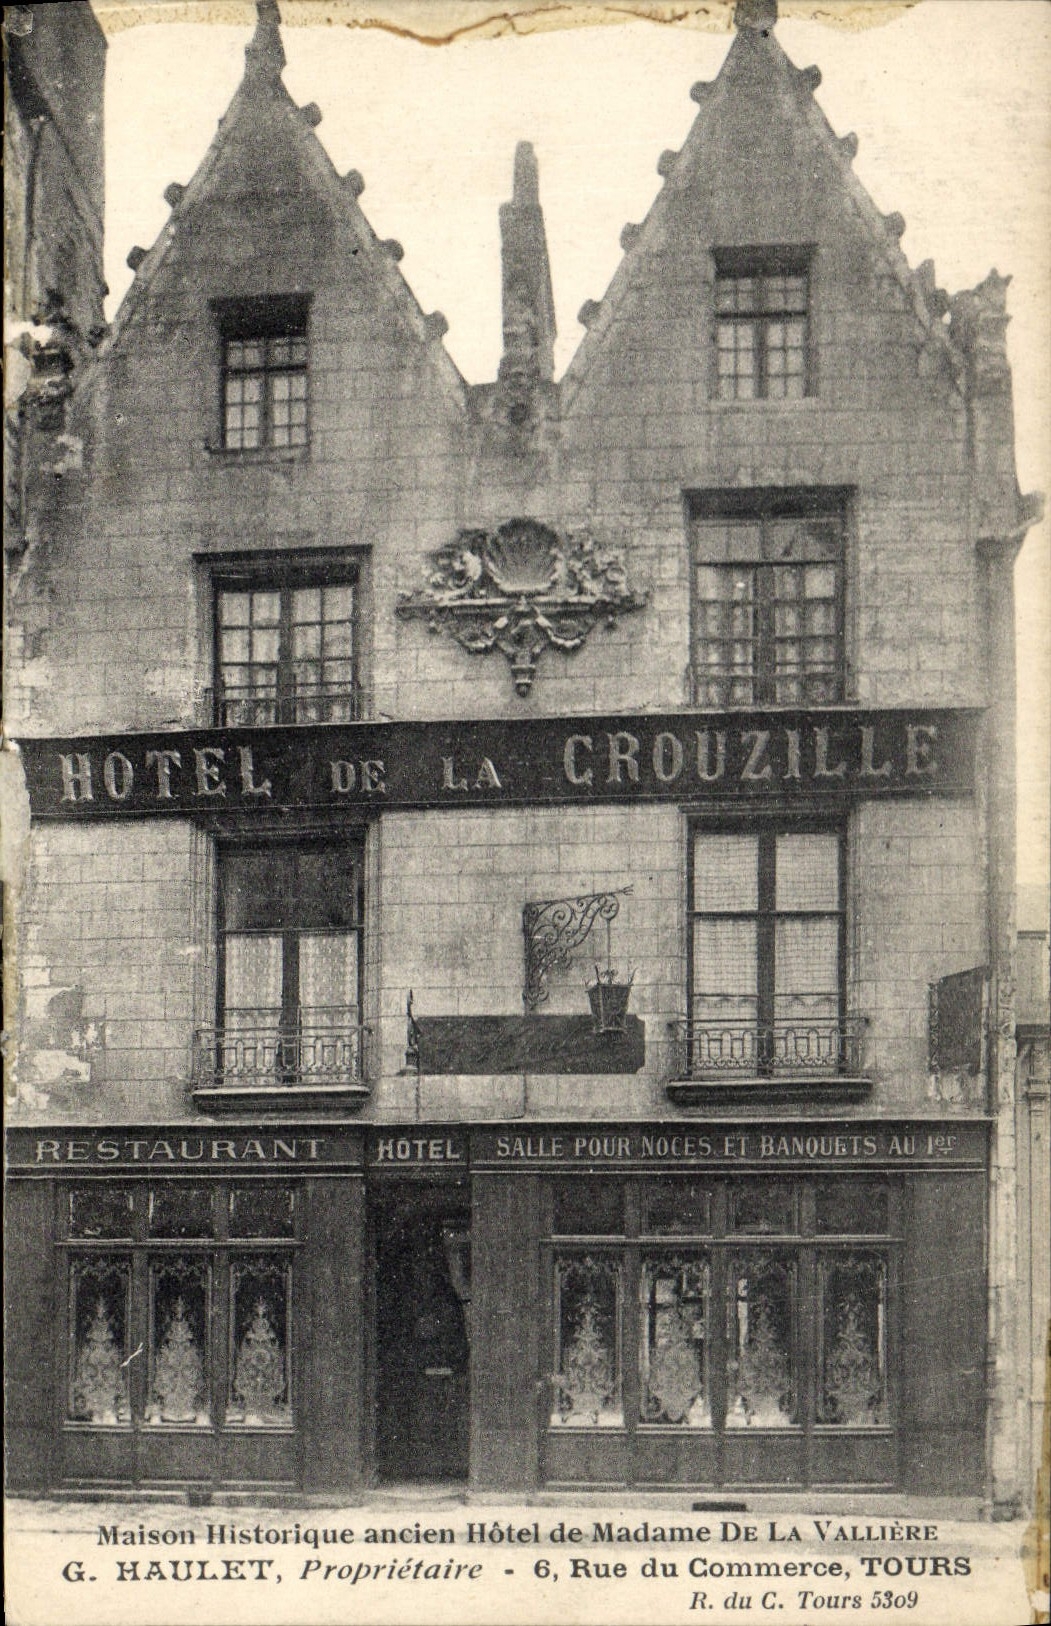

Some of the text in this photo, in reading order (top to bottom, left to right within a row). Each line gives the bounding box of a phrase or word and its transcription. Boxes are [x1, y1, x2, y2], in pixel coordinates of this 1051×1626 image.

[58, 722, 941, 803] HOTEL DE LA CROUZILLE
[35, 1137, 326, 1163] RESTAURANT
[496, 1136, 565, 1160] SALLE
[573, 1135, 632, 1158] POUR
[640, 1134, 712, 1158] NOCES
[722, 1134, 748, 1158] ET
[760, 1133, 878, 1158] BANQUETS
[887, 1133, 918, 1157] AU
